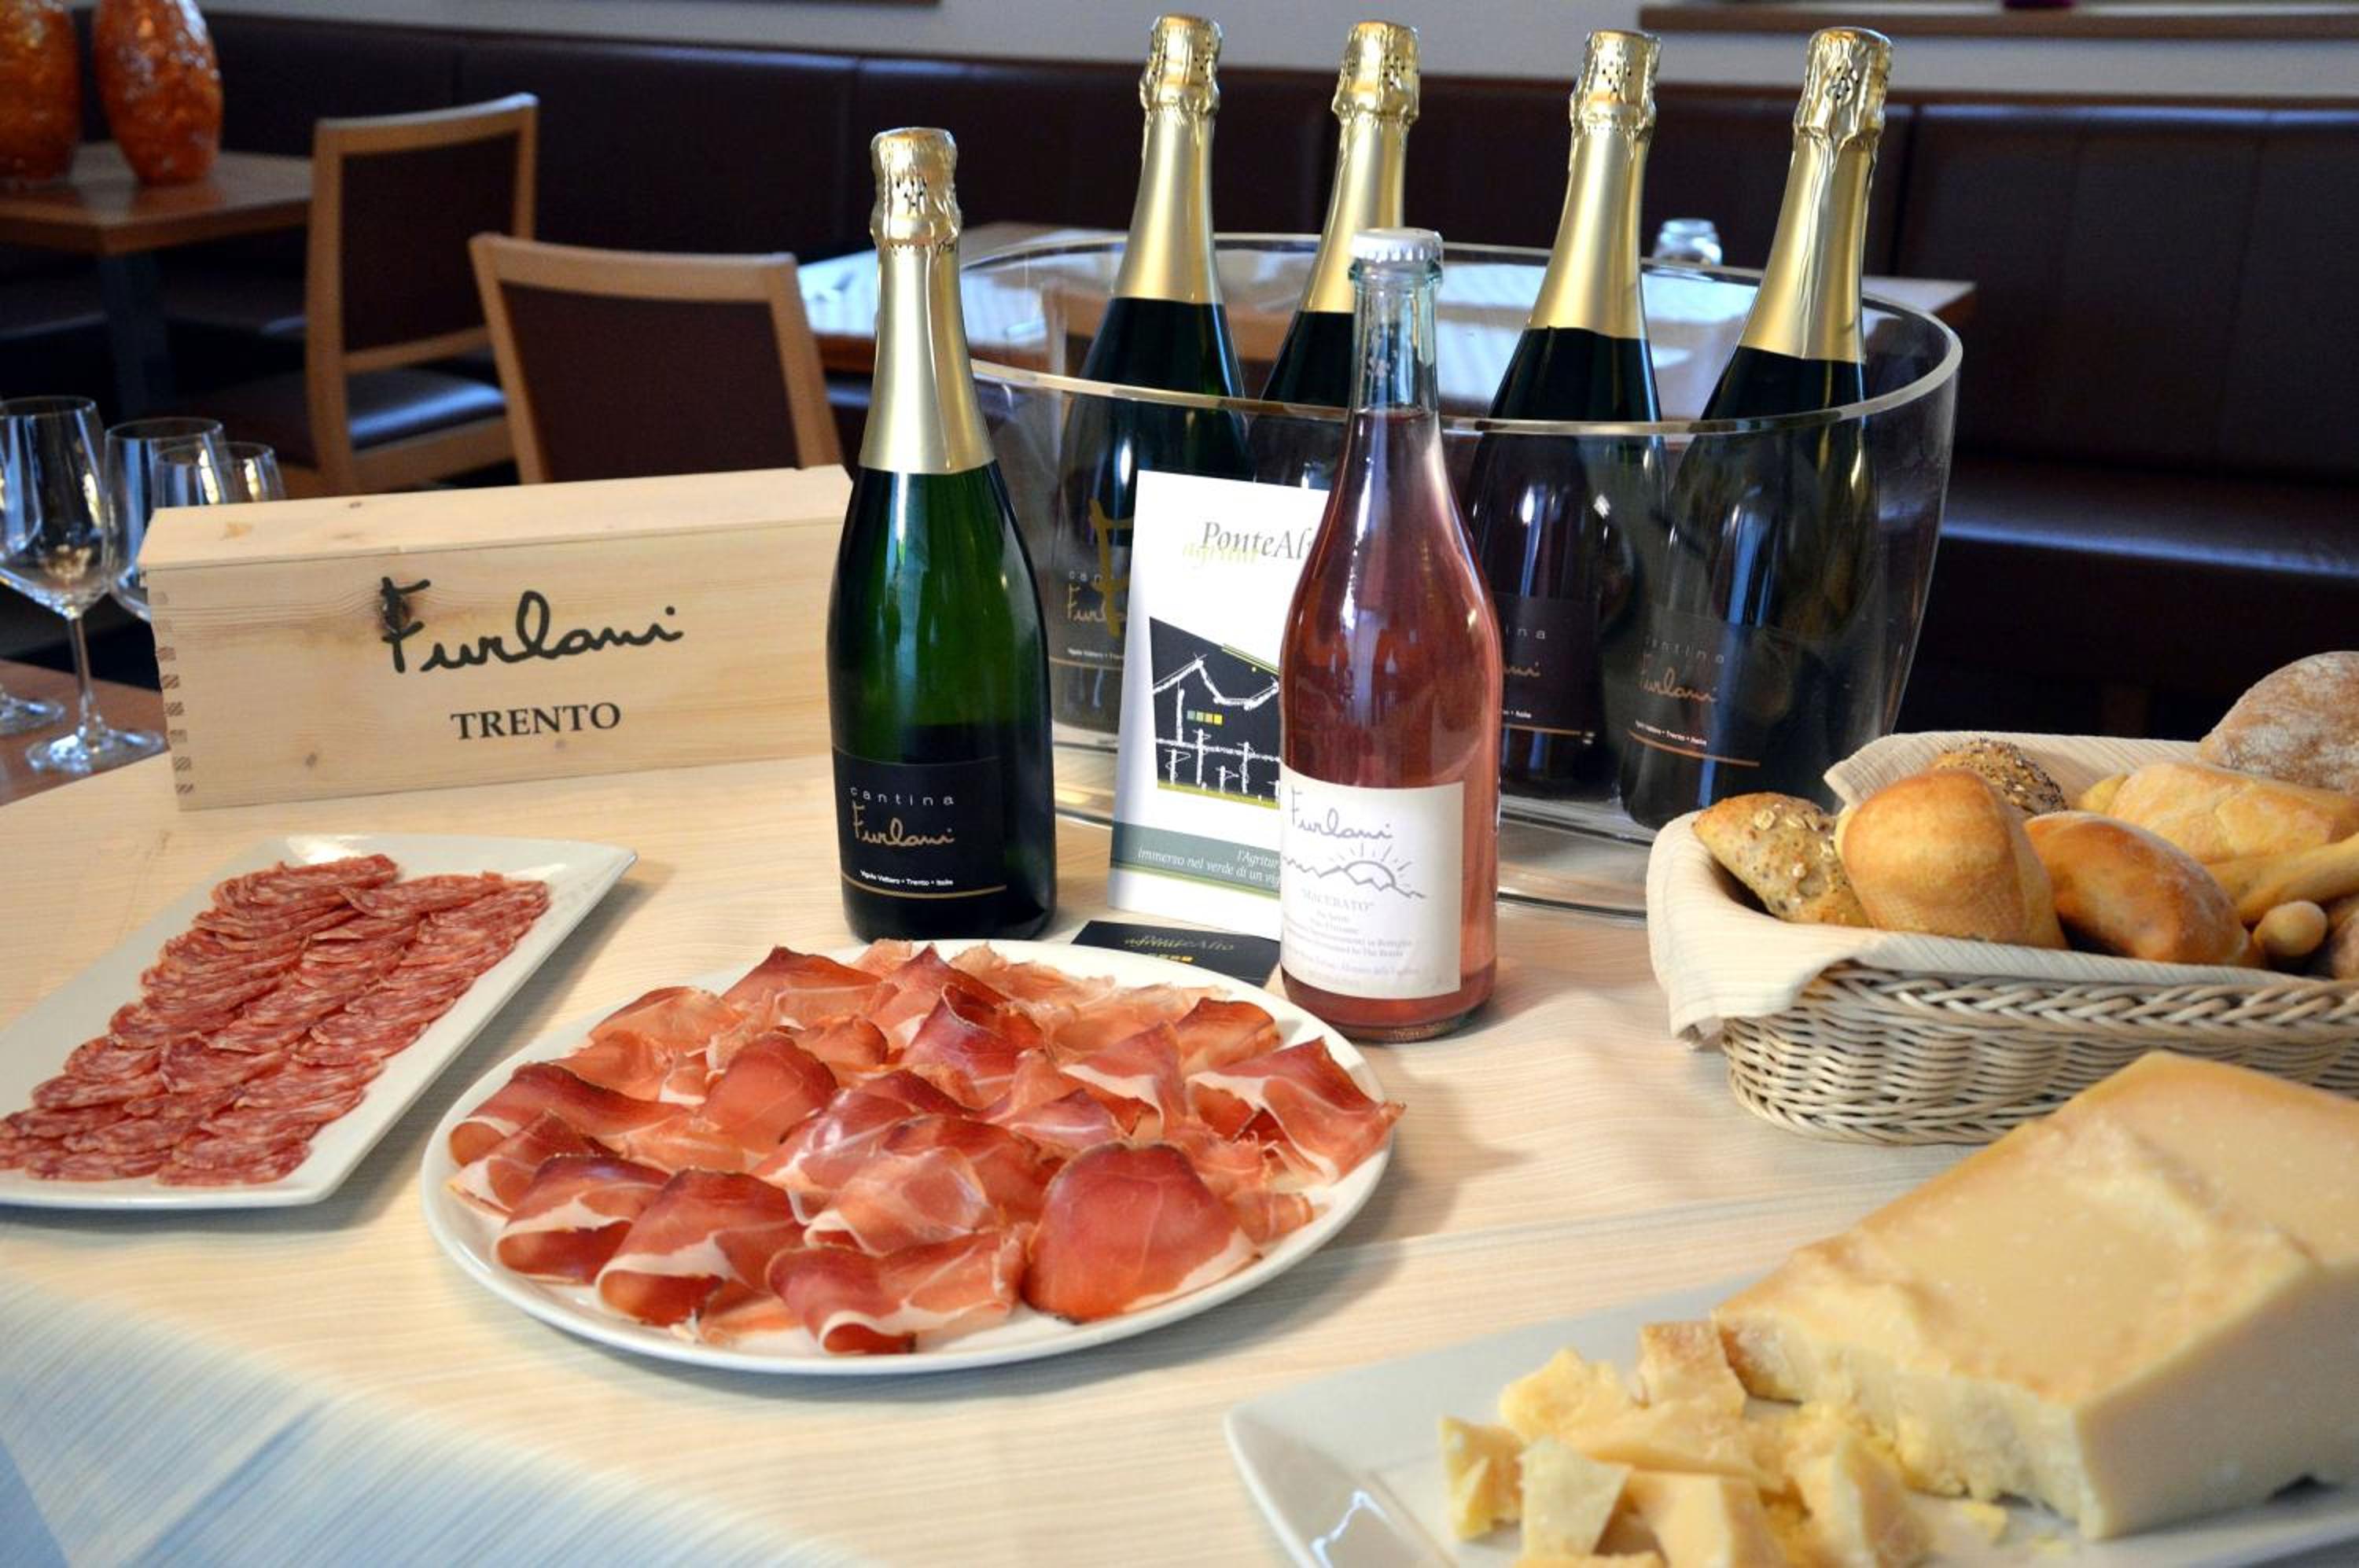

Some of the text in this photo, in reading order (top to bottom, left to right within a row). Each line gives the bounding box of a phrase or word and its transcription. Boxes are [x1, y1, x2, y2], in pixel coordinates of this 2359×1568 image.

[381, 576, 683, 673] Furlani
[451, 702, 621, 740] TRENTO
[850, 786, 954, 806] cantina
[1291, 785, 1393, 839] Furlani
[852, 799, 956, 847] Furlani
[1186, 856, 1205, 870] nel
[1206, 859, 1235, 876] verde
[1235, 865, 1247, 878] di
[1249, 870, 1263, 882] un
